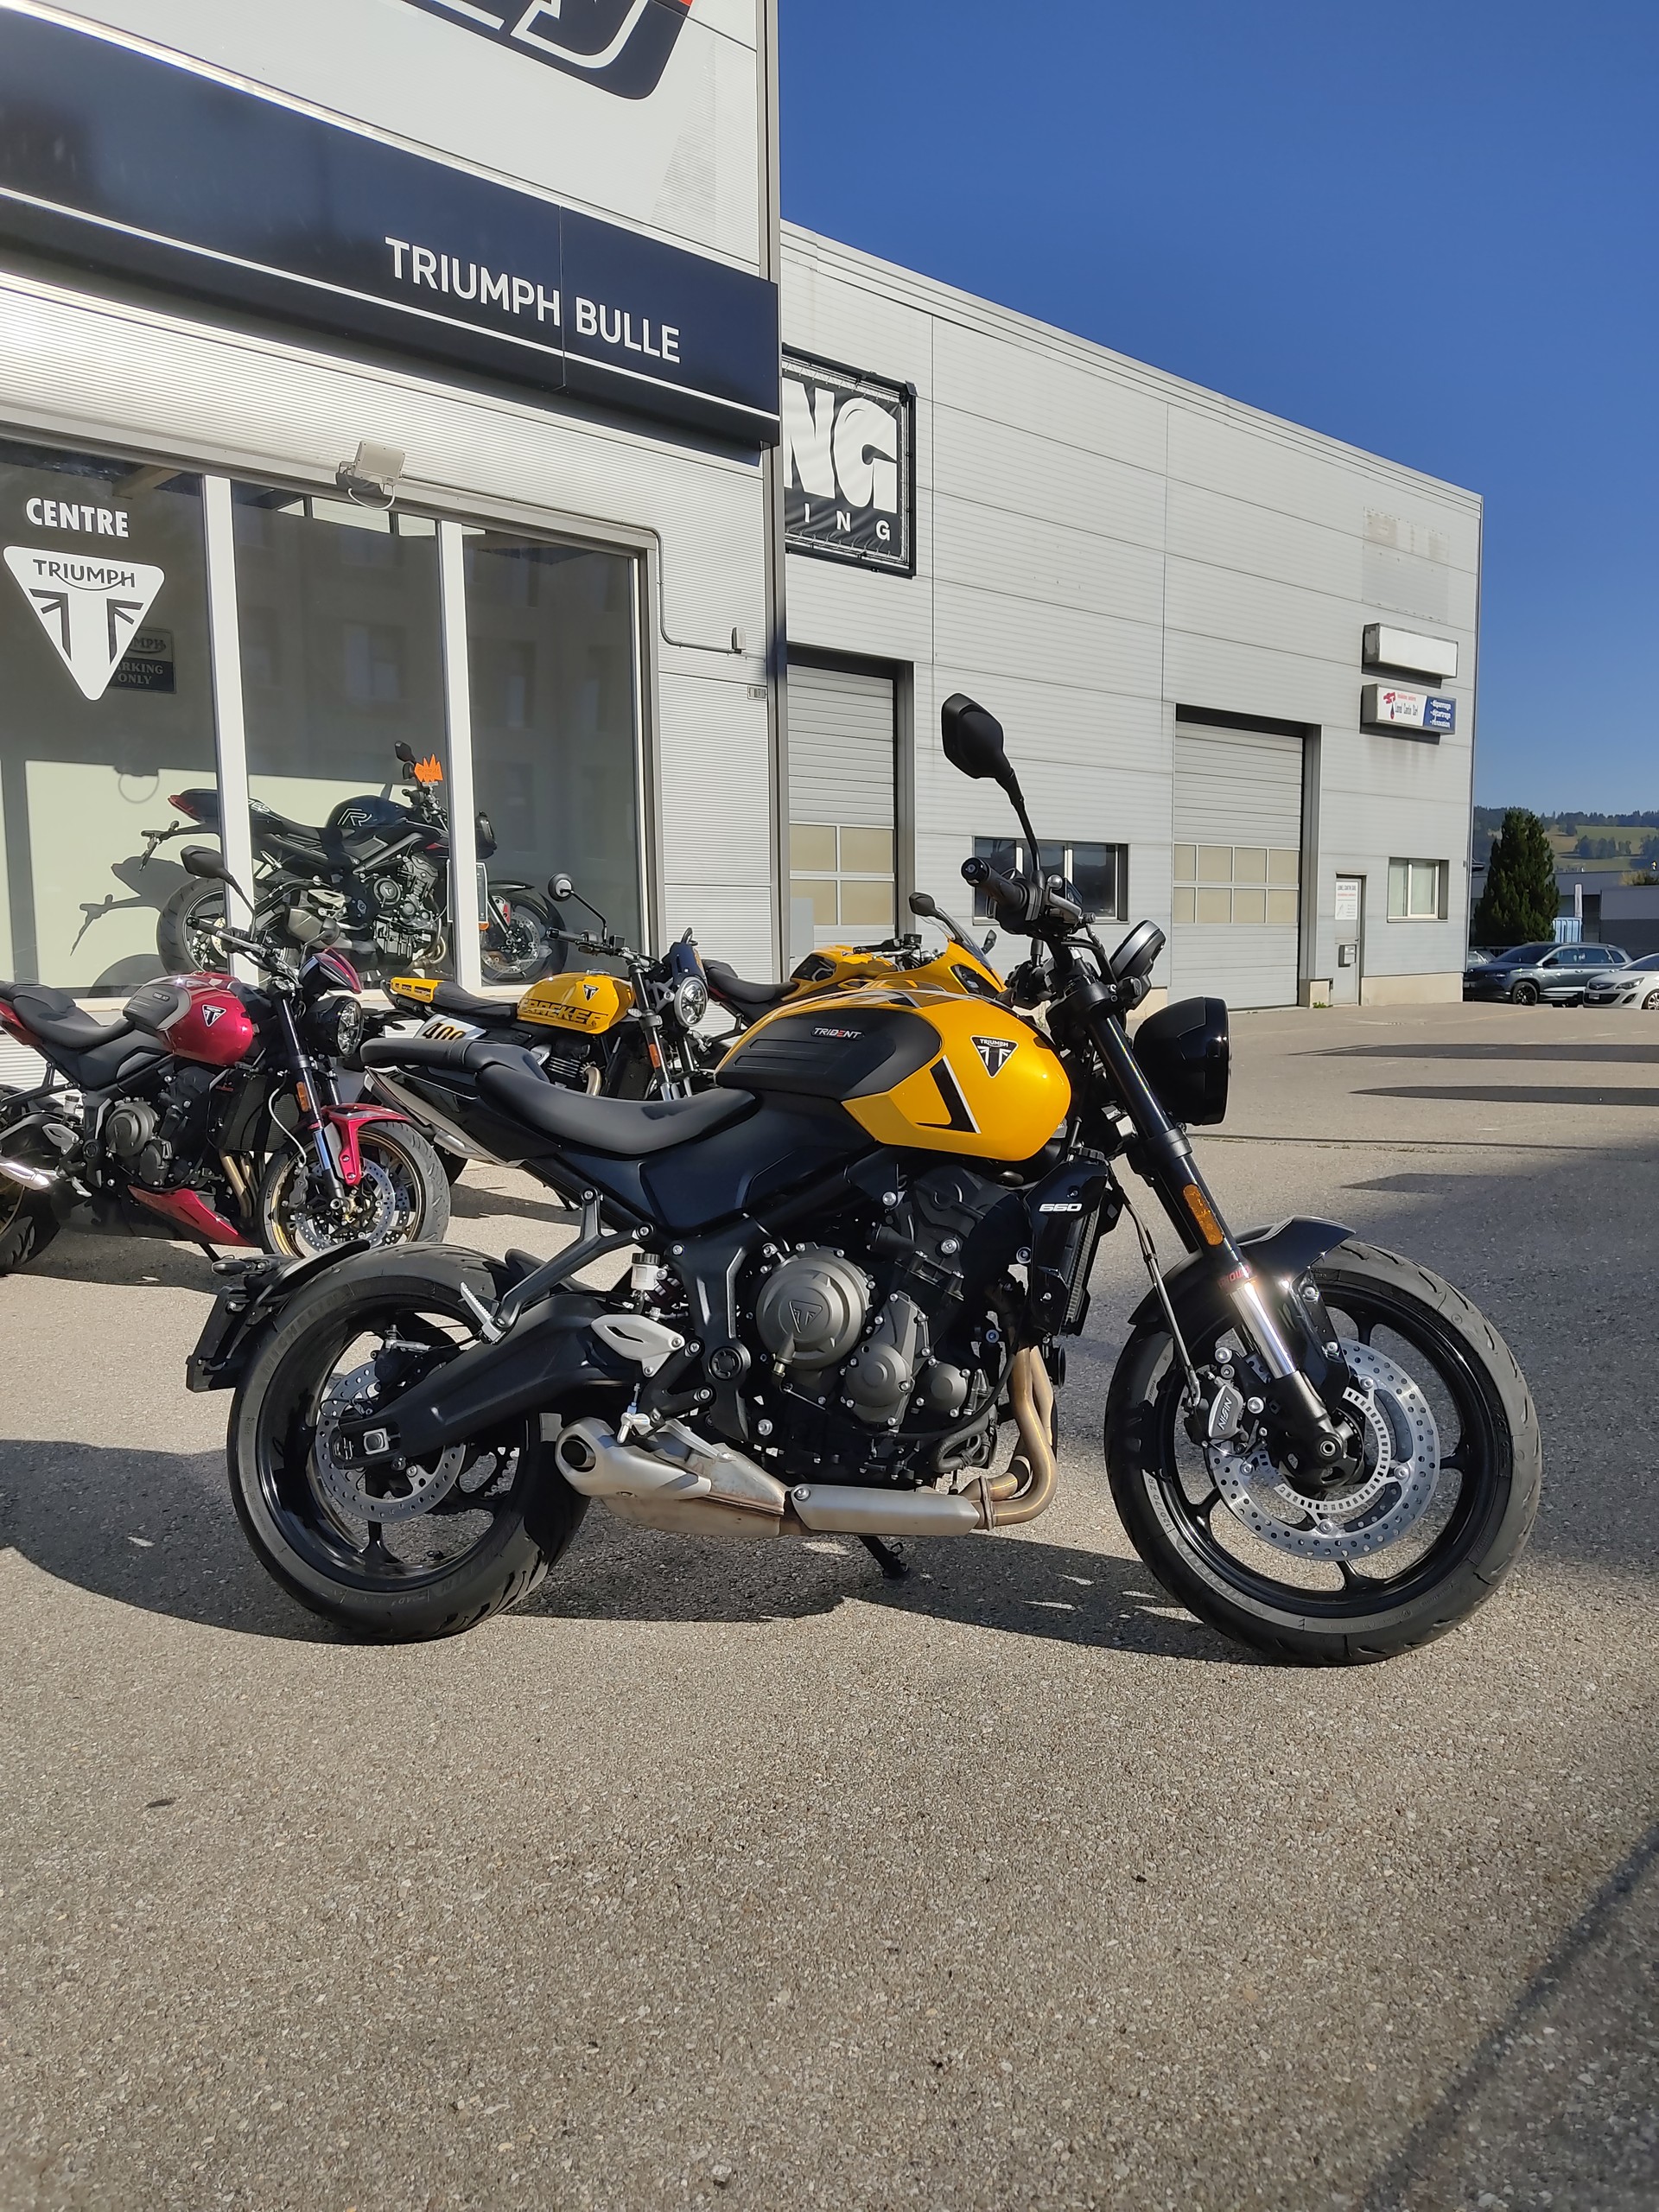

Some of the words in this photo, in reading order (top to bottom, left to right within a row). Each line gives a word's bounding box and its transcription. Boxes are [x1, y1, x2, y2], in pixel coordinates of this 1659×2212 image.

[385, 237, 561, 327] TRIUMPH
[575, 297, 680, 364] BULLE
[26, 498, 130, 537] CENTRE
[33, 558, 136, 590] TRIUMPH
[118, 673, 152, 685] ONLY
[814, 1027, 861, 1039] TRIDENT
[979, 1038, 1009, 1047] TRIUMPH
[1039, 1203, 1083, 1211] 660
[1153, 1495, 1172, 1528] 120/70
[1178, 1543, 1245, 1604] MICHELIN
